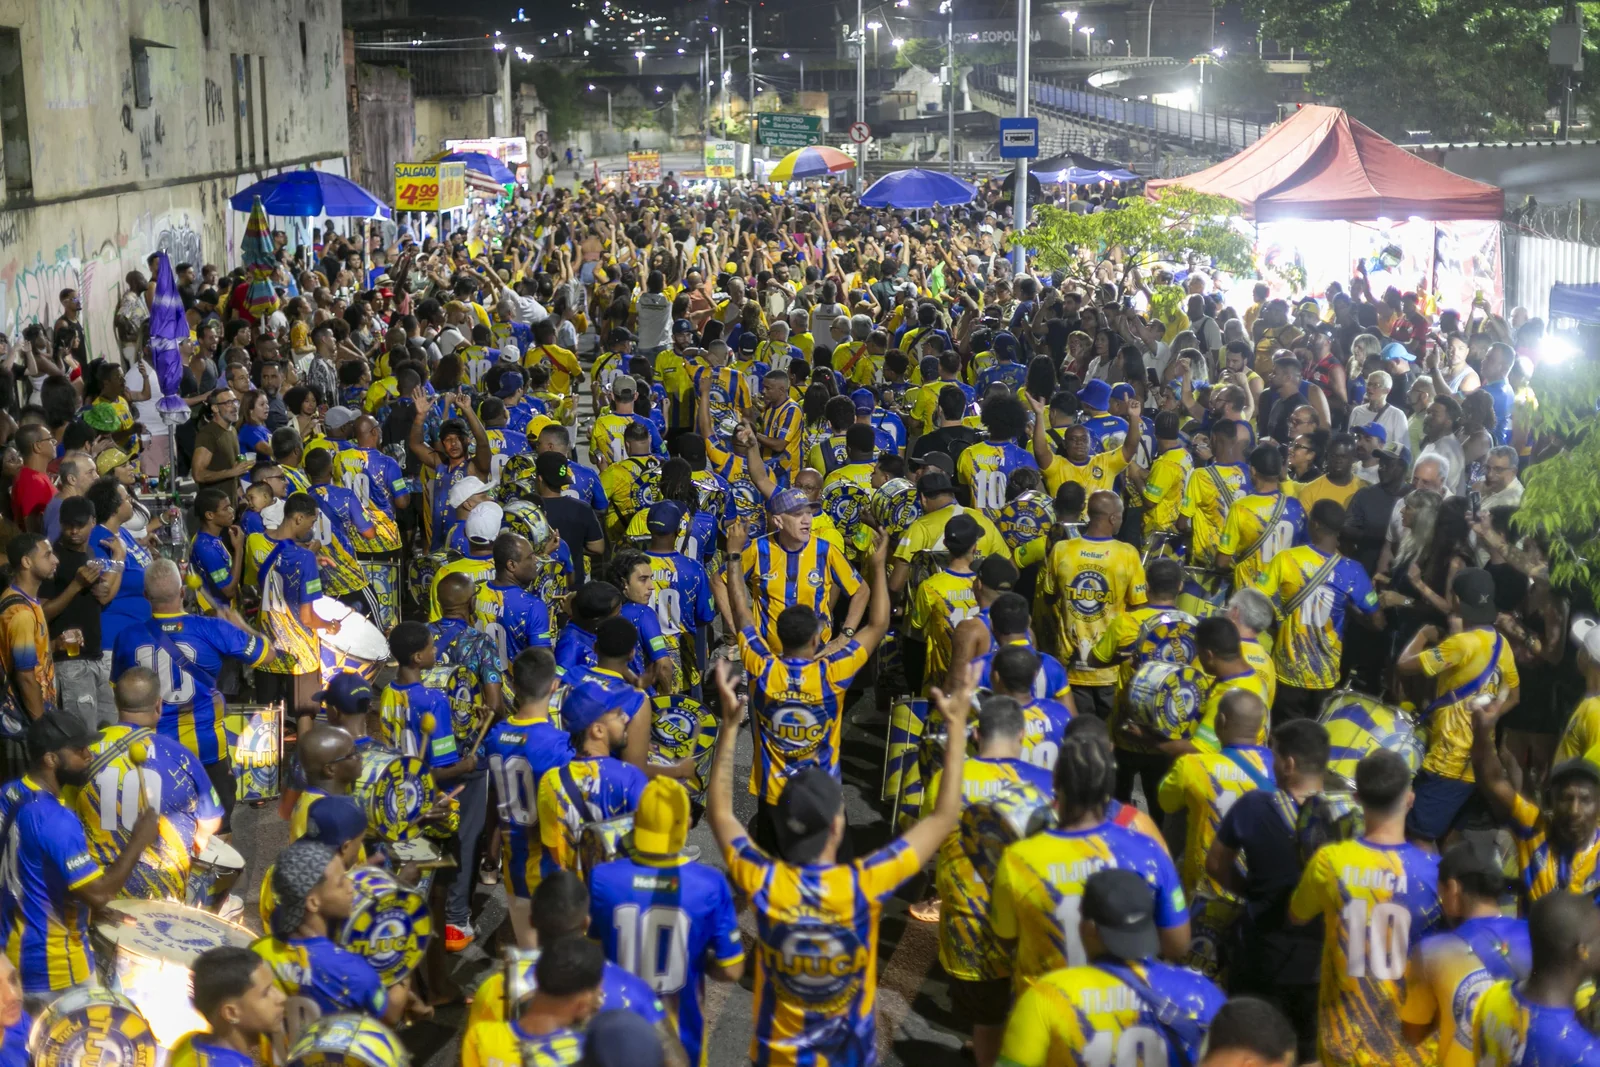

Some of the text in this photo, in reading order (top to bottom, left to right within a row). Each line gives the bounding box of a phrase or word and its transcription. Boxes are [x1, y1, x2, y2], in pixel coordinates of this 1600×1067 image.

[773, 116, 804, 124] RETORNO
[395, 166, 436, 178] SALGADOS
[343, 457, 369, 470] TIJUCA
[977, 454, 1005, 467] TIJUCA
[342, 472, 370, 508] 10
[975, 469, 1007, 510] 10
[835, 494, 863, 532] TIJUCA
[1006, 521, 1045, 537] TIJUCA
[1080, 550, 1104, 559] Heliar
[651, 571, 679, 582] JUCA
[1065, 585, 1114, 605] TIJUCA
[135, 642, 196, 703] 10
[772, 691, 816, 702] BATERIA
[655, 719, 695, 752] JUCA
[757, 712, 836, 743] TIJUCA
[1024, 719, 1054, 733] UCA
[95, 766, 162, 831] 10
[489, 754, 539, 827] 10
[1343, 866, 1409, 894] TIJUCA
[345, 932, 419, 956] TIJUCA
[613, 903, 691, 995] 10
[1342, 898, 1413, 981] 10
[762, 943, 869, 977] TIJUCA
